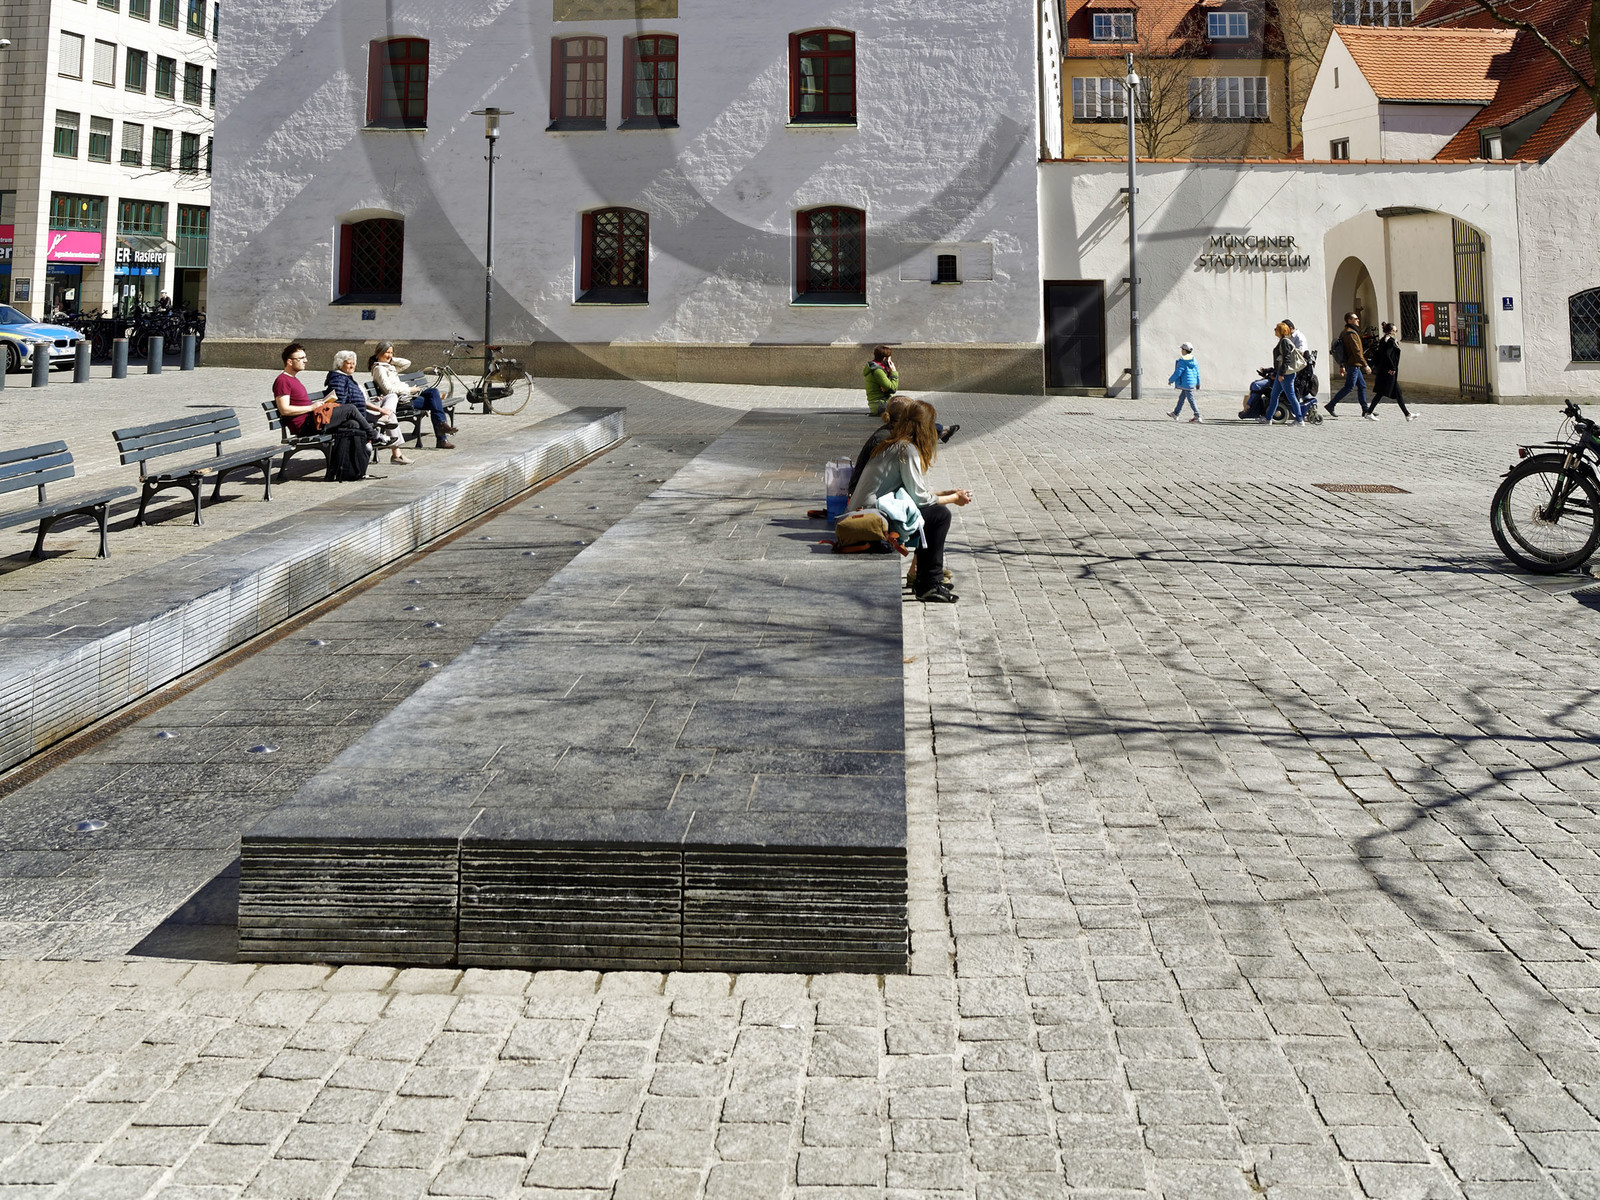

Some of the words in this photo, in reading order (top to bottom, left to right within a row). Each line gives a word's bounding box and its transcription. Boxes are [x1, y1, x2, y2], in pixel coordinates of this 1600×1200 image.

[1210, 232, 1297, 249] MÜNCHNER
[134, 250, 166, 263] Rasierer
[1199, 253, 1311, 268] STADTMUSEUM
